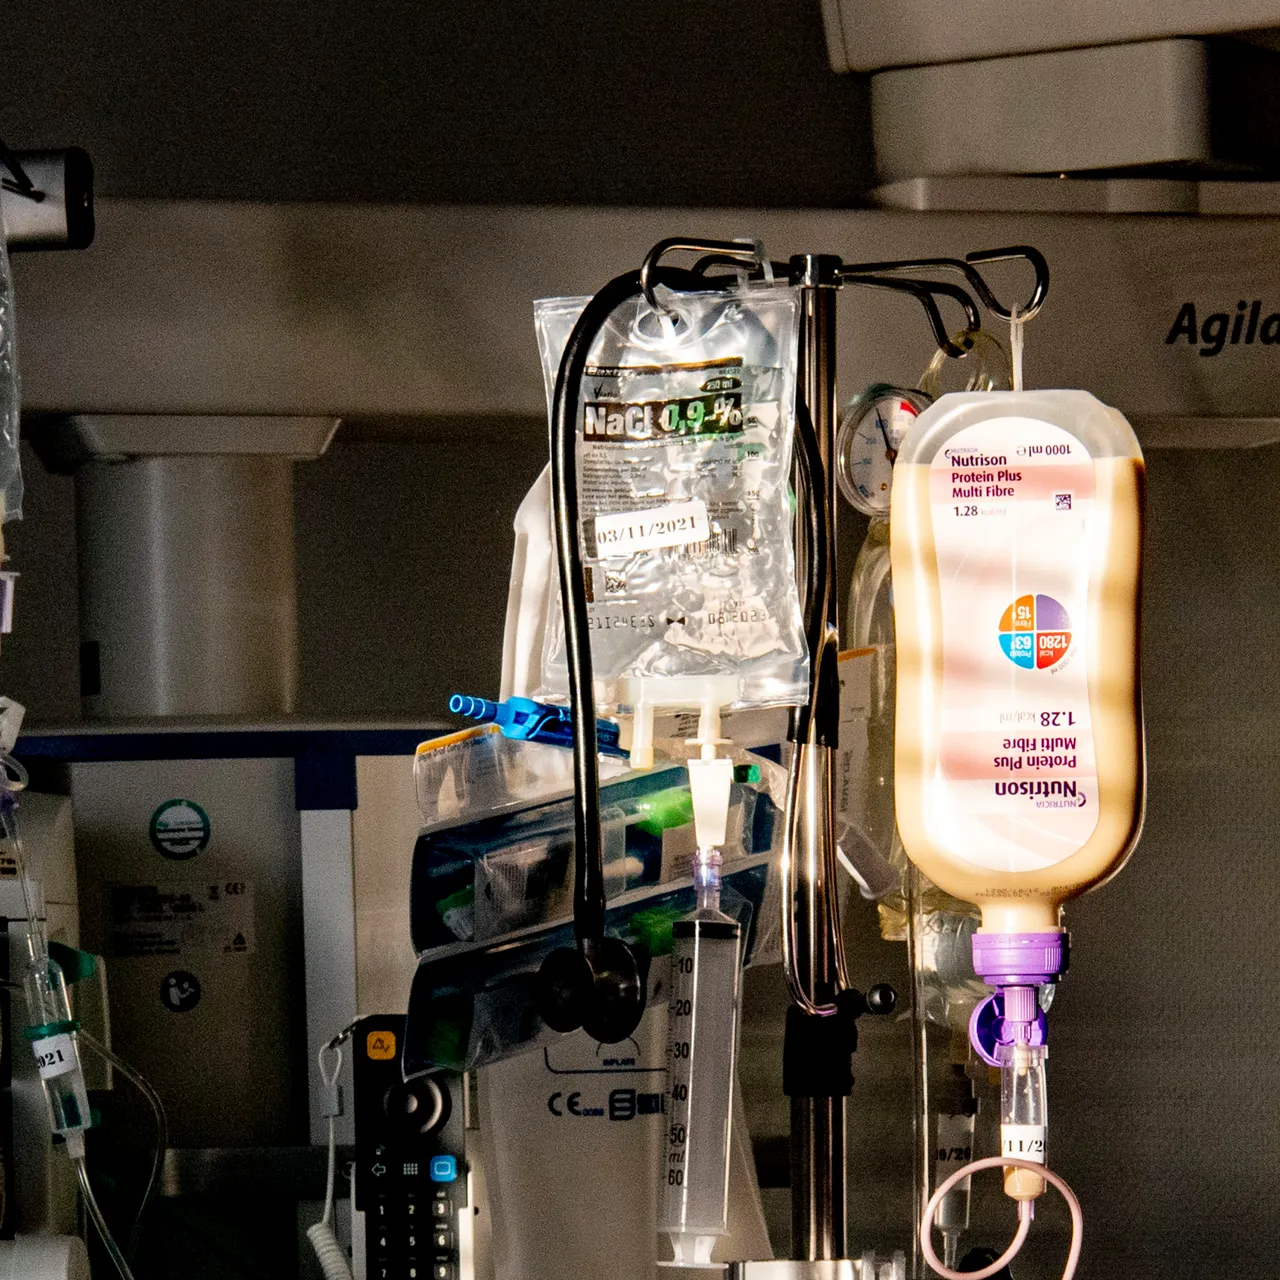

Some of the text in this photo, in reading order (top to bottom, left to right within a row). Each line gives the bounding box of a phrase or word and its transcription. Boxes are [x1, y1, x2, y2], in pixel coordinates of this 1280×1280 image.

[585, 405, 653, 438] NaCl
[1028, 444, 1072, 457] 1000 ml
[951, 454, 1007, 467] Nutrison
[952, 469, 1023, 484] Protein Plus
[952, 485, 1015, 498] Multi Fibre
[953, 505, 978, 517] 1.28
[597, 516, 697, 545] 03/11/2021
[1039, 635, 1067, 649] 1280
[1040, 711, 1076, 727] 1.28
[1002, 737, 1077, 753] Multi Fibre
[993, 755, 1077, 771] Protein Plus
[995, 780, 1077, 800] Nutrison
[1036, 800, 1077, 809] NUTRICIA
[678, 957, 693, 974] 10
[675, 1000, 691, 1017] 20
[673, 1042, 689, 1059] 30
[37, 1049, 65, 1069] 021
[672, 1084, 687, 1101] 40
[670, 1127, 686, 1144] 50
[668, 1169, 684, 1186] 60
[408, 1204, 415, 1215] 2
[438, 1235, 446, 1246] 6
[439, 1266, 446, 1278] 9
